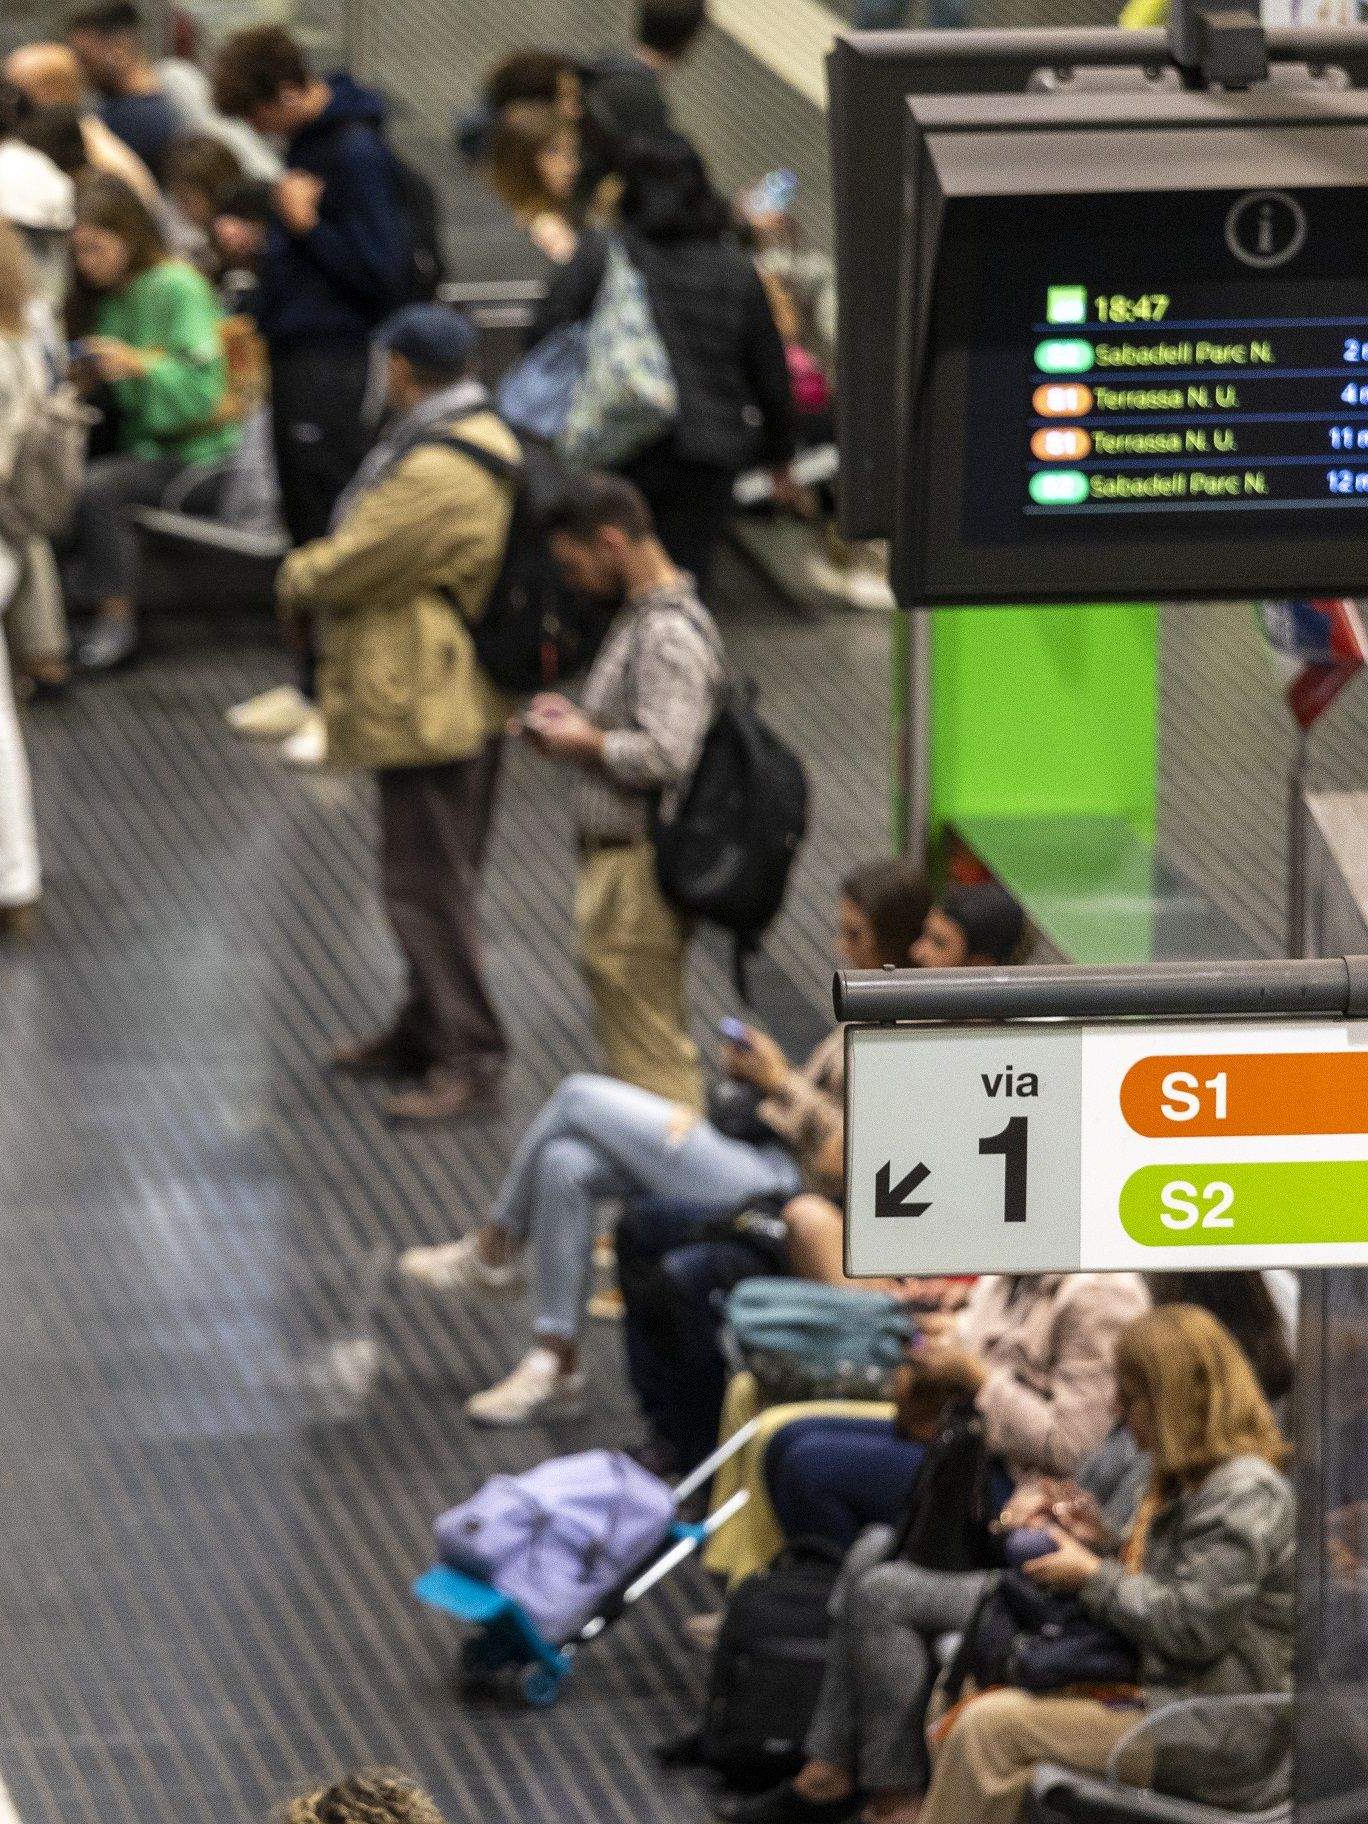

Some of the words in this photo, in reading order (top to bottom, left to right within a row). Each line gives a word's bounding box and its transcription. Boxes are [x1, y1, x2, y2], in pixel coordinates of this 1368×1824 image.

[1095, 294, 1170, 323] 18:47
[1095, 340, 1193, 367] Sabadell
[1195, 340, 1247, 365] Parc
[1093, 385, 1184, 410] Terrassa
[1091, 429, 1183, 455] Terrassa
[1089, 472, 1187, 498] Sabadell
[1189, 471, 1241, 496] Parc
[980, 1065, 1039, 1098] via
[1160, 1071, 1228, 1121] S1
[978, 1116, 1028, 1223] 1
[1159, 1181, 1235, 1229] S2
